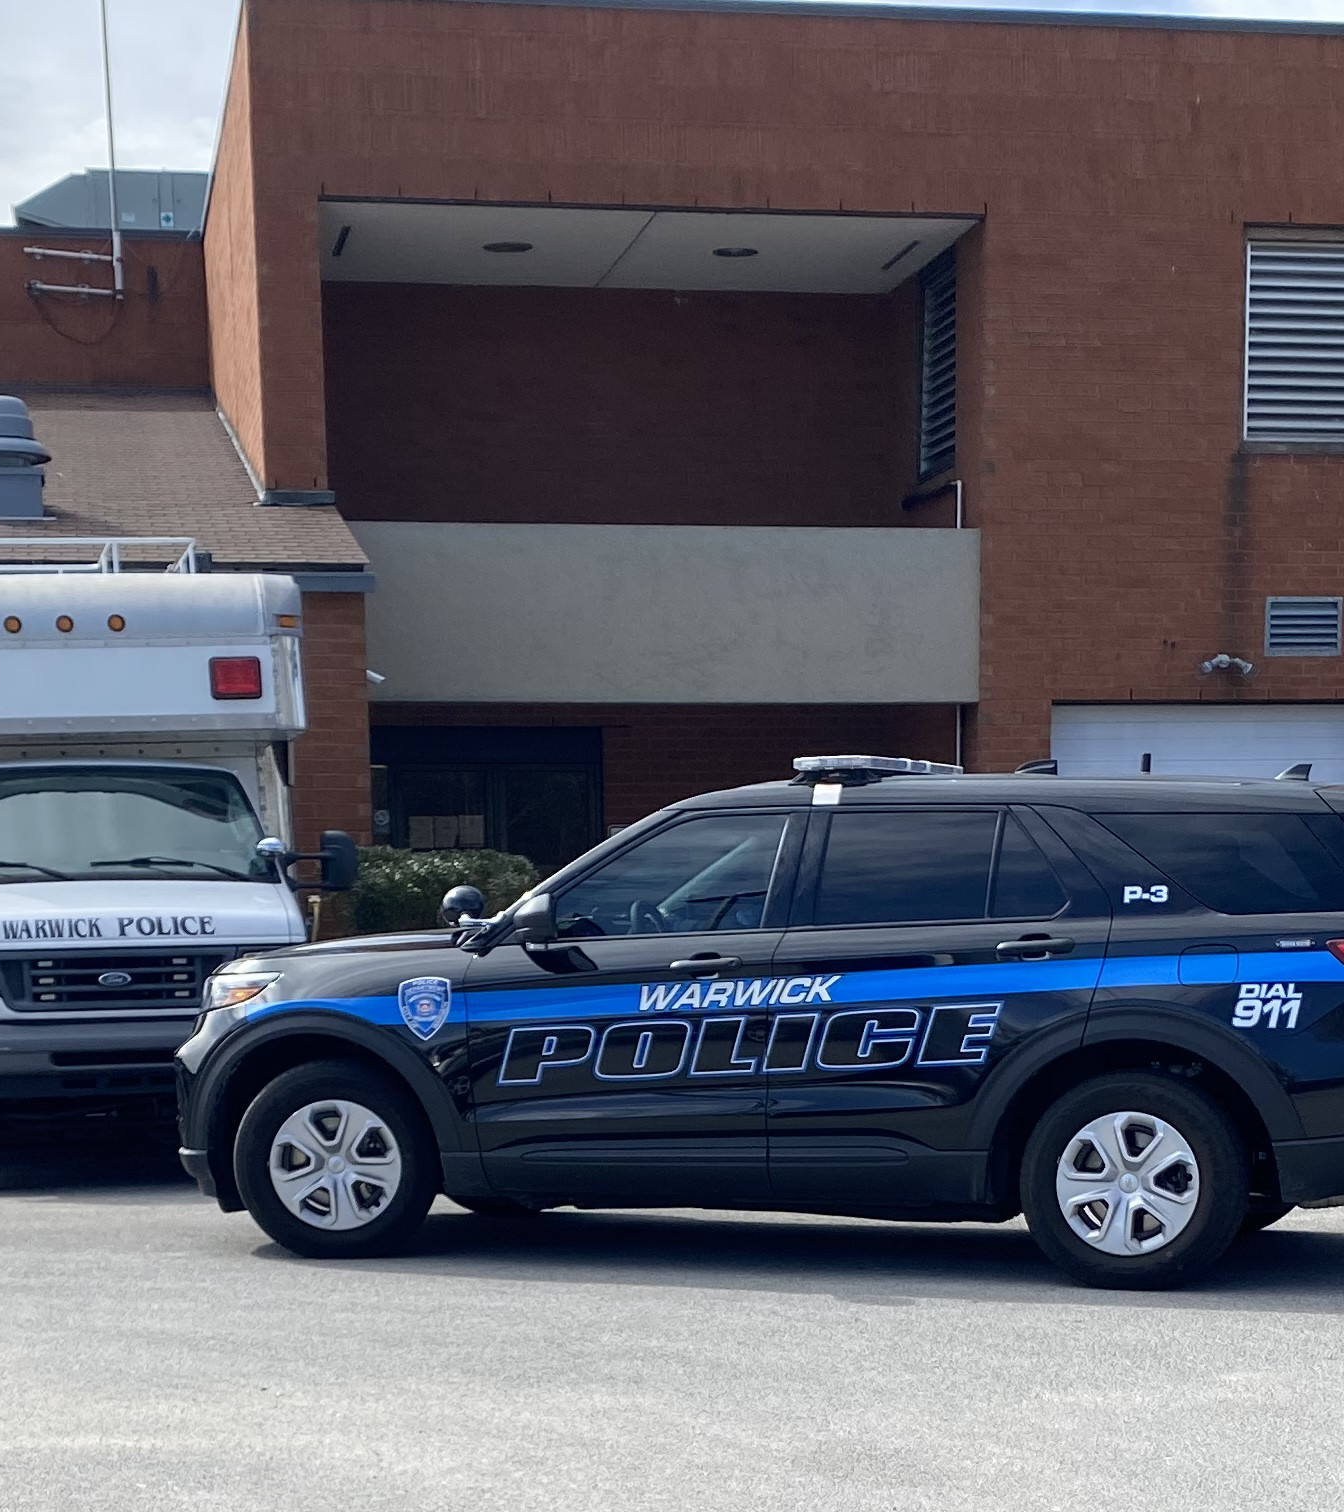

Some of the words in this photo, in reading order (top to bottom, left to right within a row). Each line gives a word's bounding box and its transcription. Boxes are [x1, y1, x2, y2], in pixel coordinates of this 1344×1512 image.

[1123, 885, 1169, 903] P-3
[1, 917, 103, 940] WARWICK
[117, 915, 216, 937] POLICE
[638, 974, 844, 1012] WARWICK
[1238, 983, 1303, 999] DIAL
[1232, 998, 1301, 1029] 911
[496, 1000, 1005, 1087] POLICE
